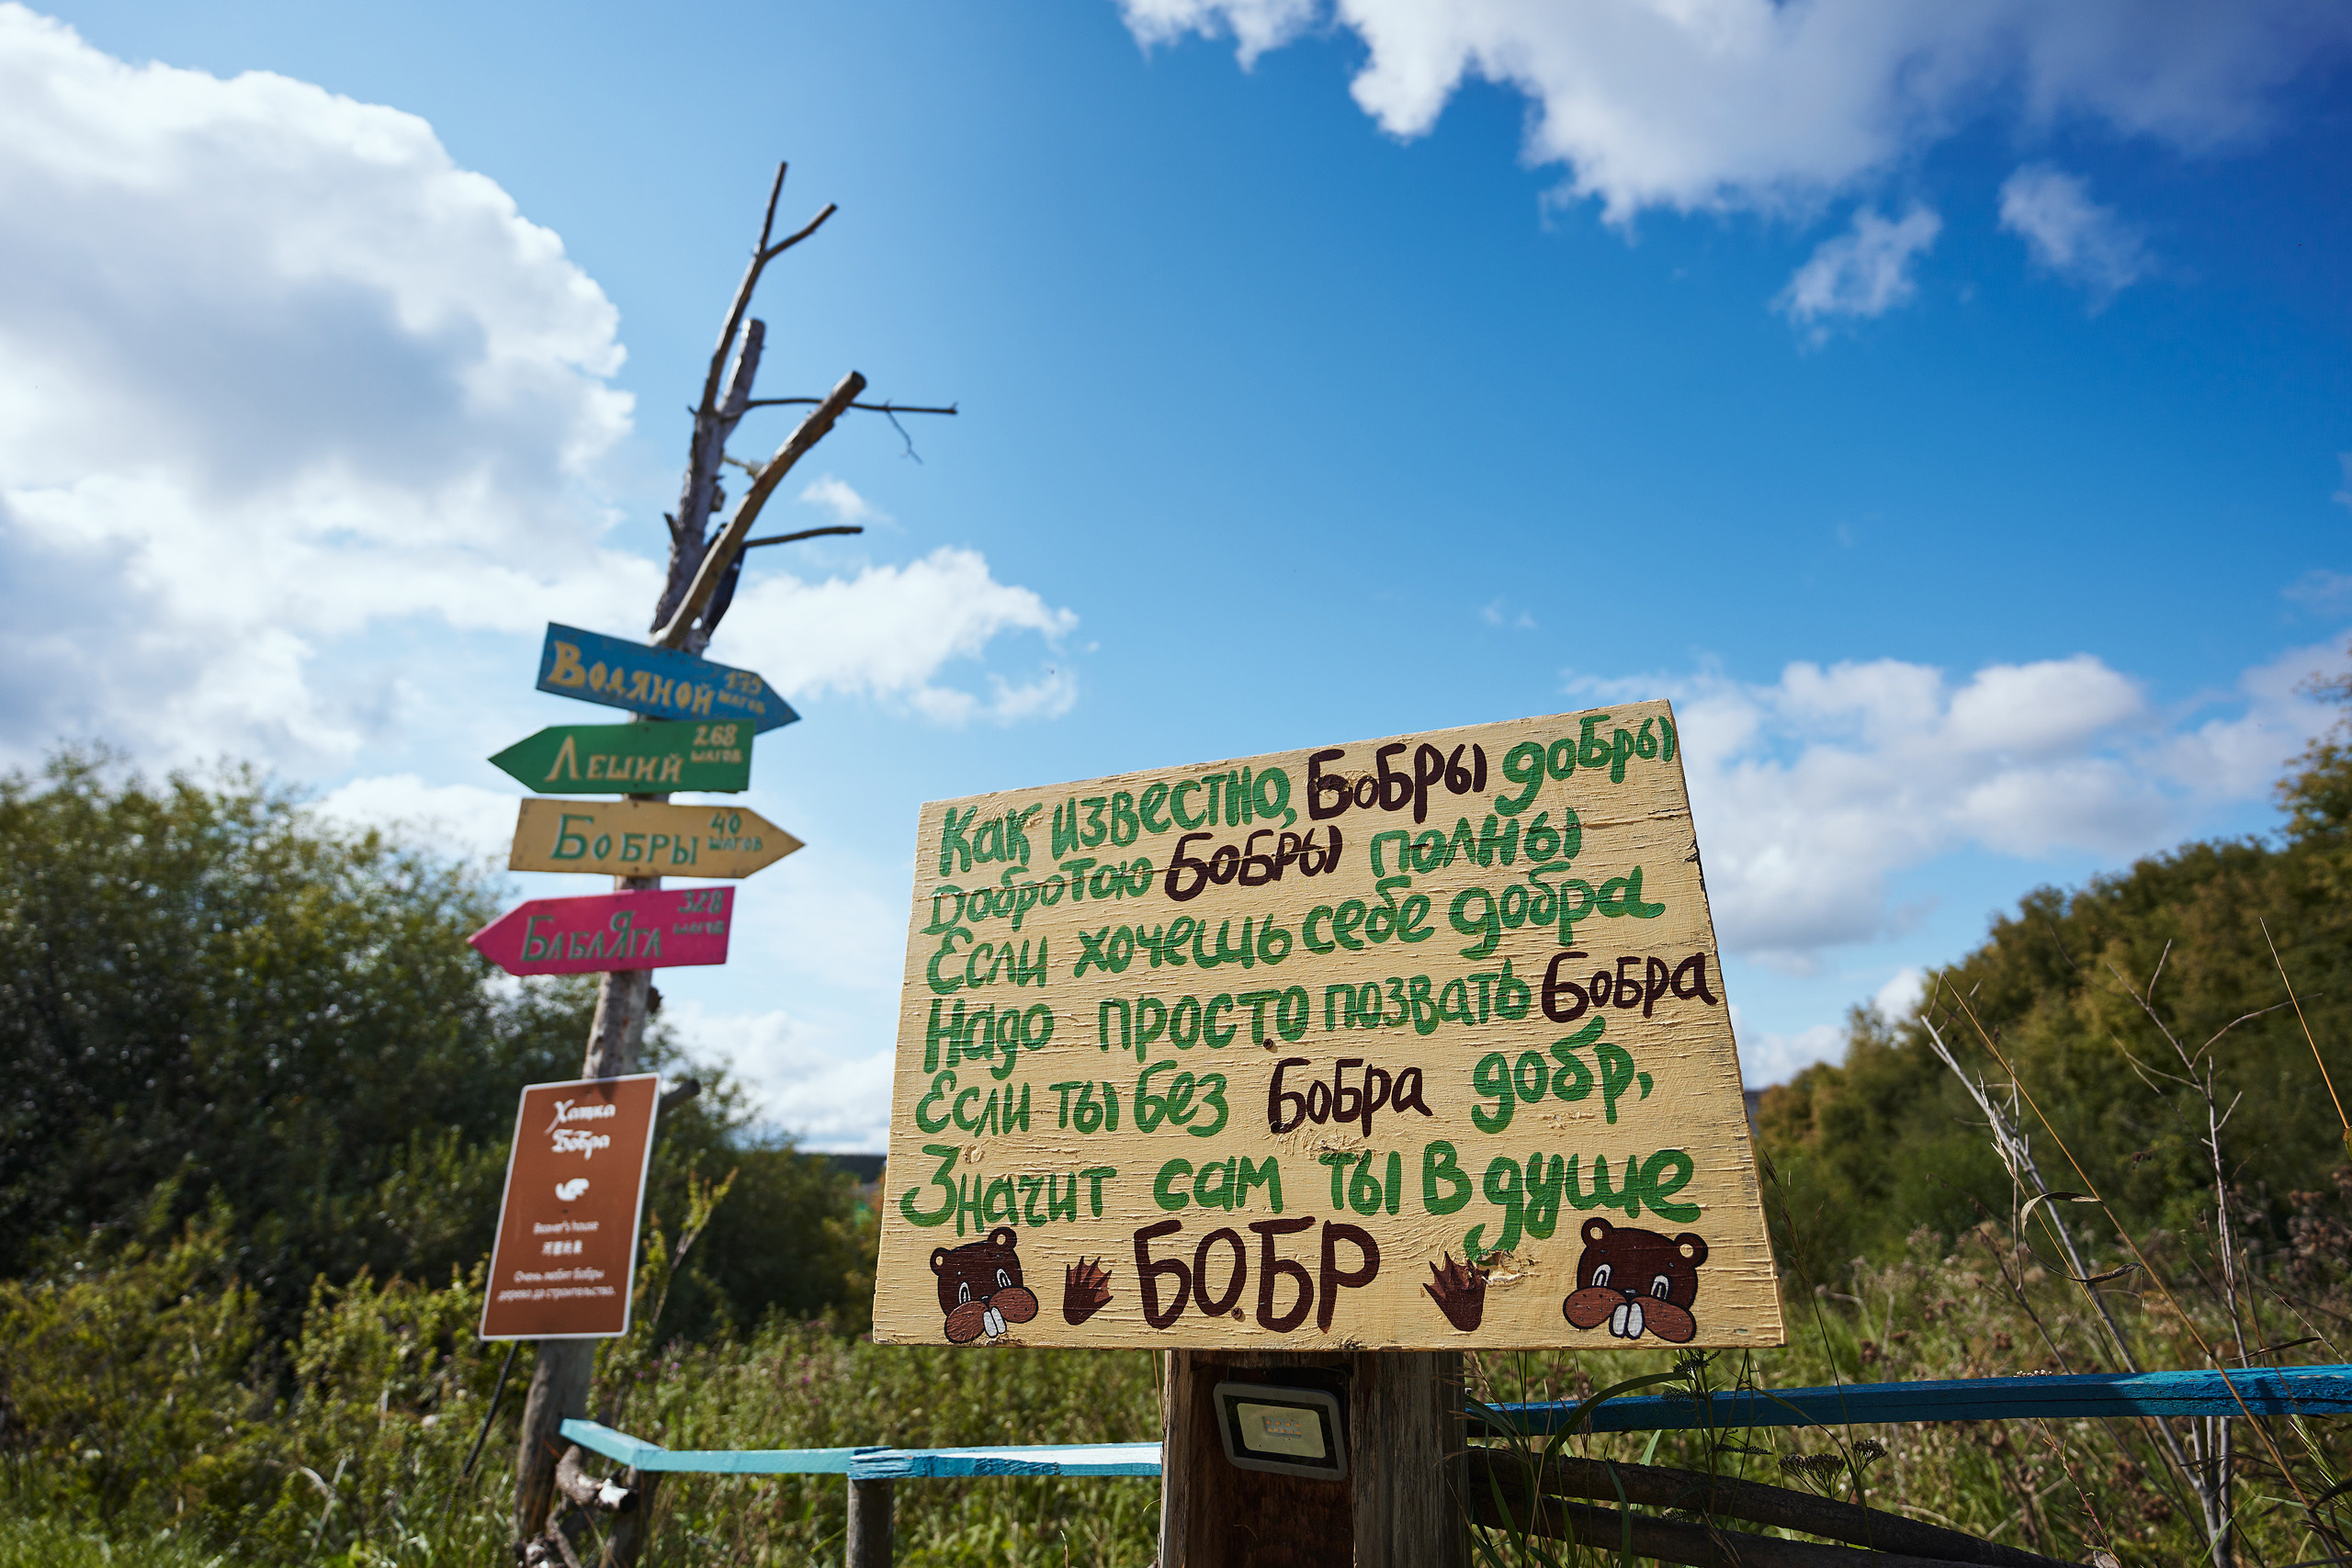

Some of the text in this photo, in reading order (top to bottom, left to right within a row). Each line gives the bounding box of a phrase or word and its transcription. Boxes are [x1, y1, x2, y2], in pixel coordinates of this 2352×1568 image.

[693, 724, 739, 748] 268
[709, 813, 742, 835] 40
[940, 803, 1043, 877] Как
[1369, 807, 1583, 878] полны
[678, 889, 725, 914] 328
[927, 861, 1667, 995] Если хочешь себе добра
[923, 998, 1055, 1081] Надо
[1098, 985, 1311, 1064] просто
[1324, 957, 1532, 1036] позвать
[915, 1069, 1032, 1138] Если
[1048, 1080, 1121, 1134] ты
[1470, 1014, 1655, 1134] добр,
[899, 1144, 1117, 1238] Значит
[1152, 1155, 1284, 1214] сам
[1317, 1148, 1403, 1216] ты
[1463, 1147, 1702, 1262] душе
[1134, 1215, 1381, 1335] БОБР
